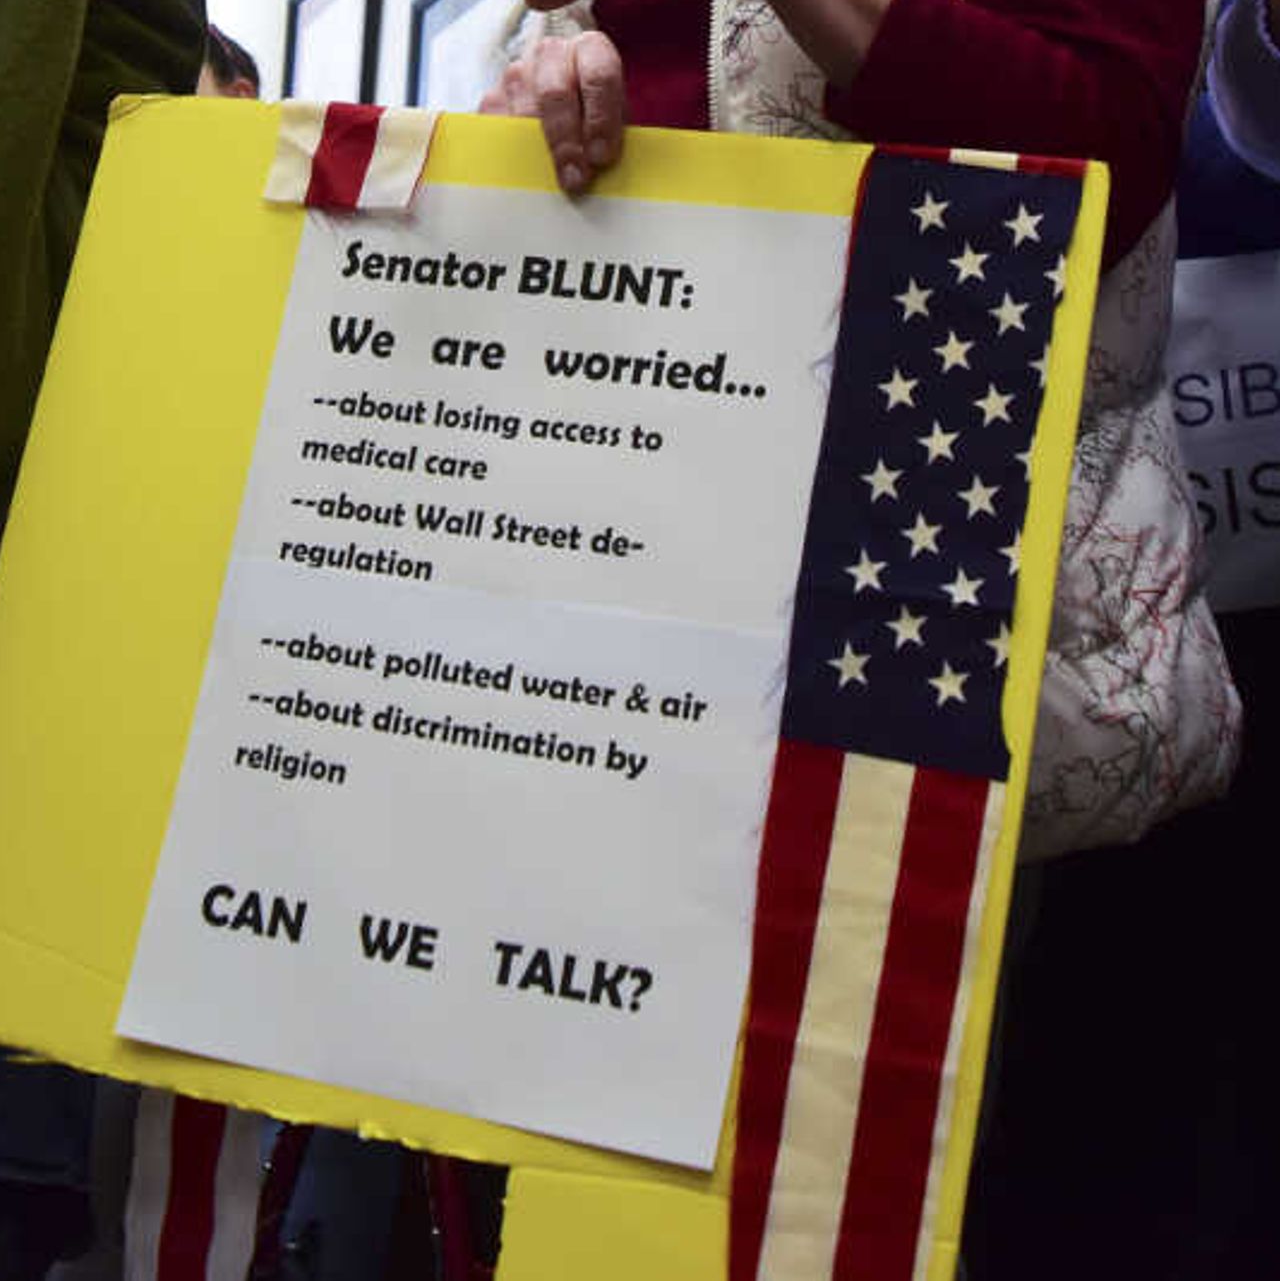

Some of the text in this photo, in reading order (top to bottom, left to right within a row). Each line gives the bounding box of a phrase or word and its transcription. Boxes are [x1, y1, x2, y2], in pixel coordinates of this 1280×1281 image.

[341, 240, 694, 310] Senator BLUNT:
[328, 315, 767, 397] We are worried...
[433, 399, 522, 440] losing
[529, 419, 622, 448] access
[630, 424, 664, 452] to
[301, 438, 488, 481] medical care
[279, 540, 433, 582] regulation
[415, 503, 485, 539] Wall
[491, 513, 583, 552] Street
[590, 526, 645, 558] de-
[382, 650, 515, 693] polluted
[521, 675, 617, 708] water
[624, 683, 650, 714] &
[659, 691, 708, 723] air
[234, 743, 347, 785] religion
[371, 702, 597, 767] discrimination
[604, 740, 649, 781] by
[201, 884, 653, 1013] CAN WE TALK?
